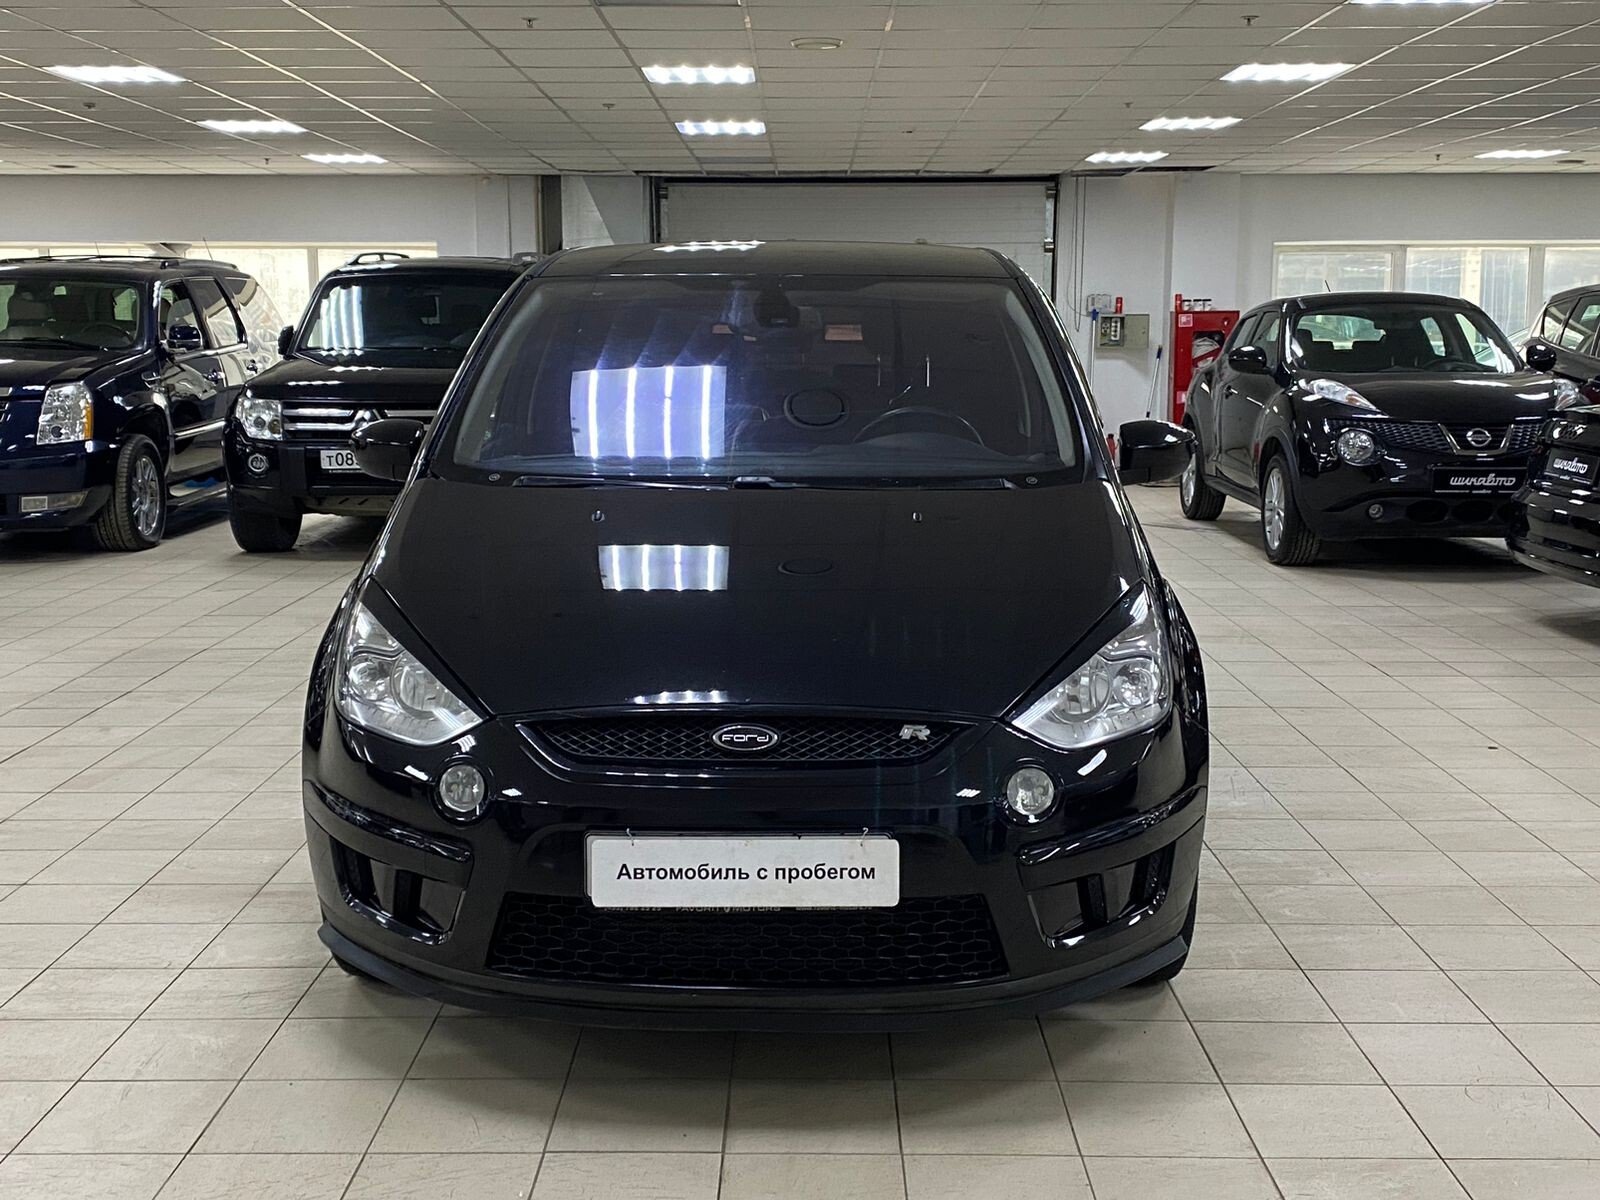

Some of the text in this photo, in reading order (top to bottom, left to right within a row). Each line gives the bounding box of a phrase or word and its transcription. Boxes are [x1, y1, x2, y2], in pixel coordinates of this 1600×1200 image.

[326, 452, 359, 466] T08
[1449, 473, 1516, 486] шикавто
[616, 863, 876, 884] Автомобиль с пробегом
